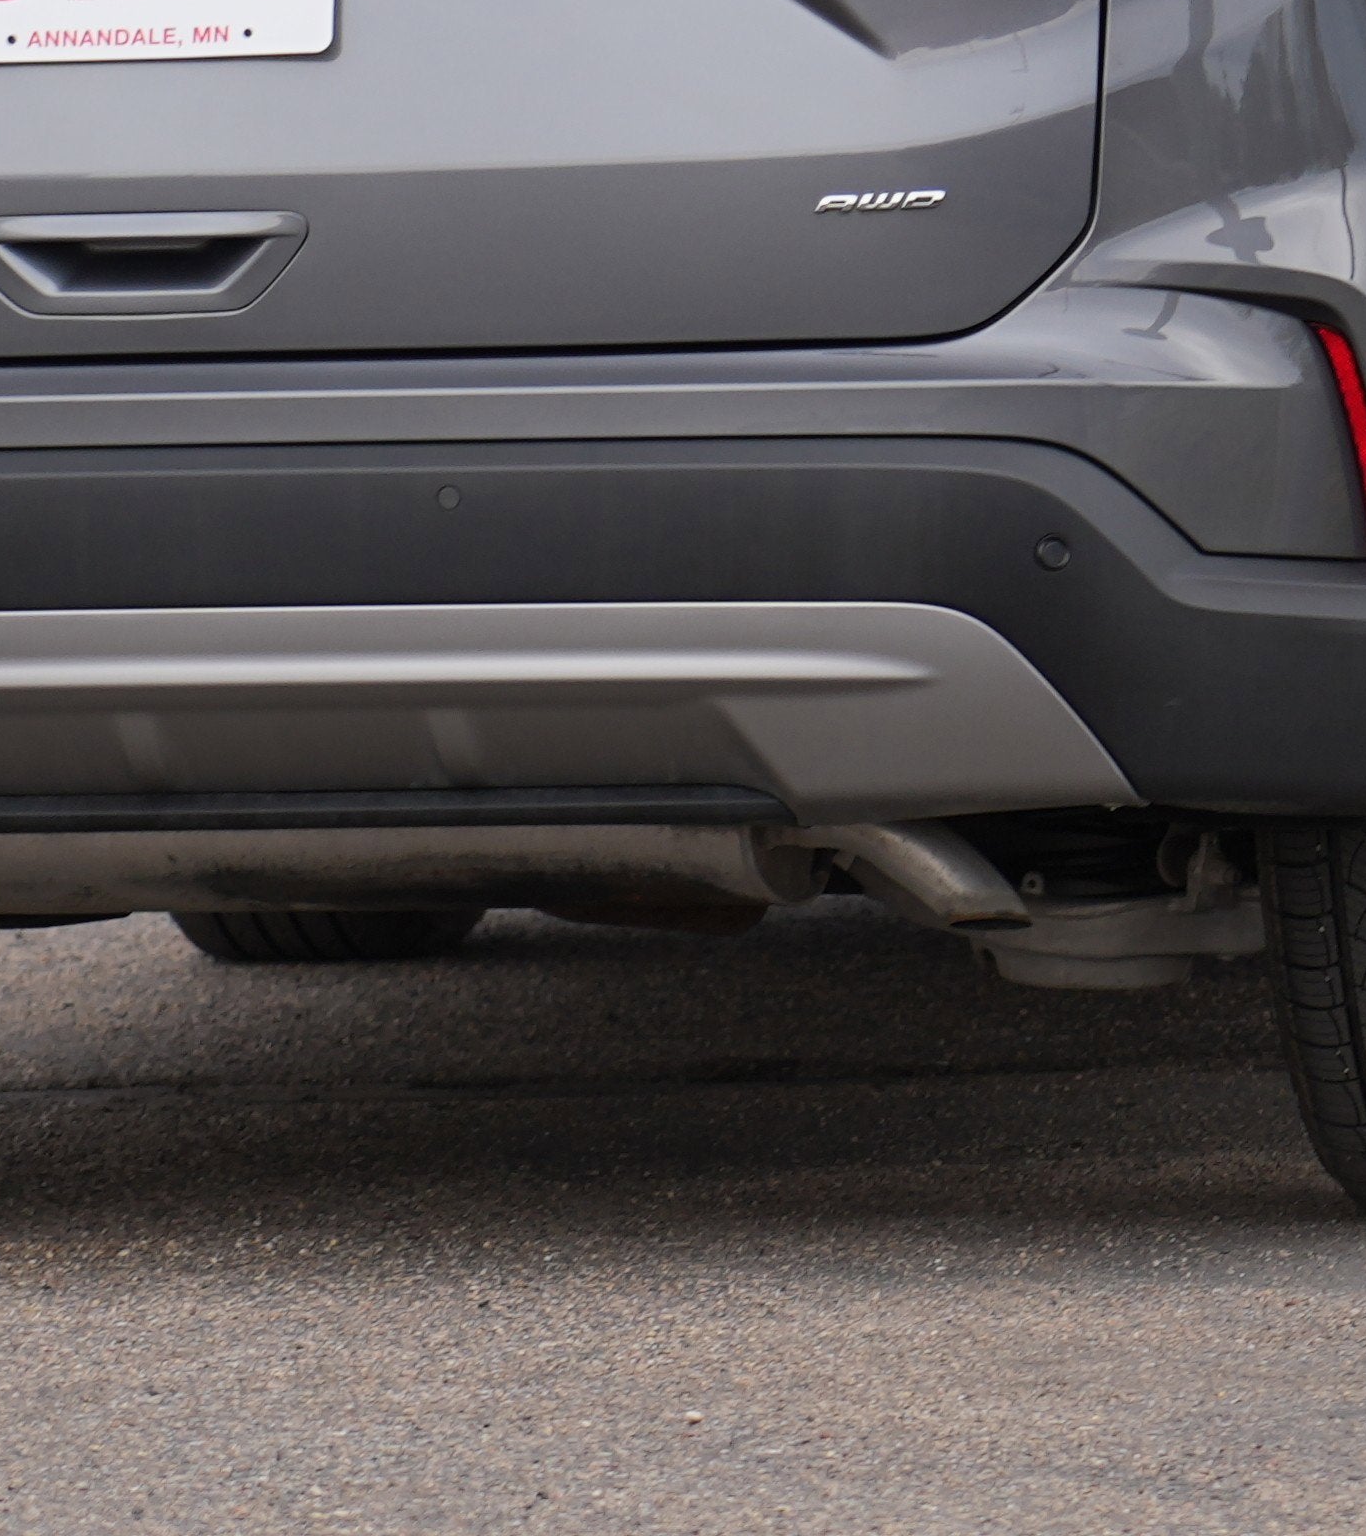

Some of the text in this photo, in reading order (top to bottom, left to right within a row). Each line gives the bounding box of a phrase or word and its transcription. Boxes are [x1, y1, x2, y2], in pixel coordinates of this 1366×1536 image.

[27, 25, 229, 48] ANNANDALE, MN
[814, 190, 947, 213] AWD
